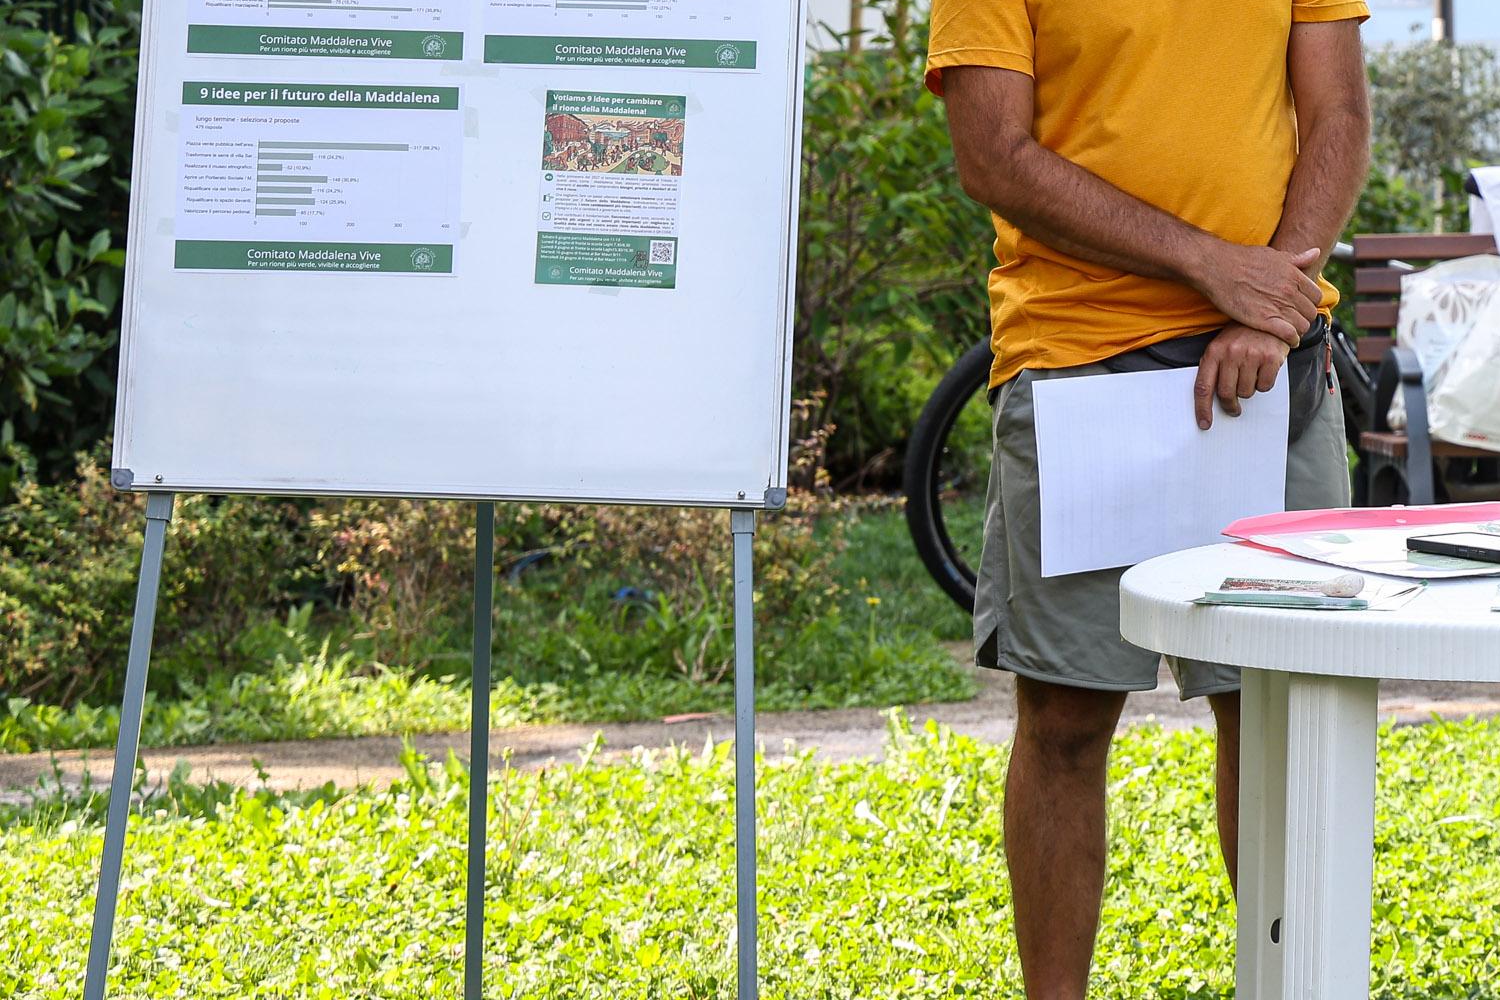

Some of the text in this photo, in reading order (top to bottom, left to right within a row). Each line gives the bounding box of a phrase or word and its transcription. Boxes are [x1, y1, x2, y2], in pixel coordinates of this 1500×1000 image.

[259, 34, 393, 48] Comitato Maddalena Vive
[259, 45, 271, 53] Per
[298, 46, 309, 54] più
[329, 47, 351, 55] vivibile
[356, 49, 392, 57] accogliente
[555, 44, 687, 57] Comitato Maddalena Vive
[593, 56, 604, 64] più
[604, 56, 624, 64] verde,
[651, 58, 686, 66] accogliente
[200, 87, 440, 104] 9 idee per il futuro della Maddalena
[553, 94, 663, 106] Votiamo 9 idee per cambiare
[552, 103, 647, 116] il rione della Maddalena!
[247, 249, 382, 261] Comitato Maddalena Vive
[286, 261, 297, 269] più
[297, 261, 317, 269] verde,
[345, 262, 381, 270] accogliente
[569, 266, 664, 278] Comitato Maddalena Vive
